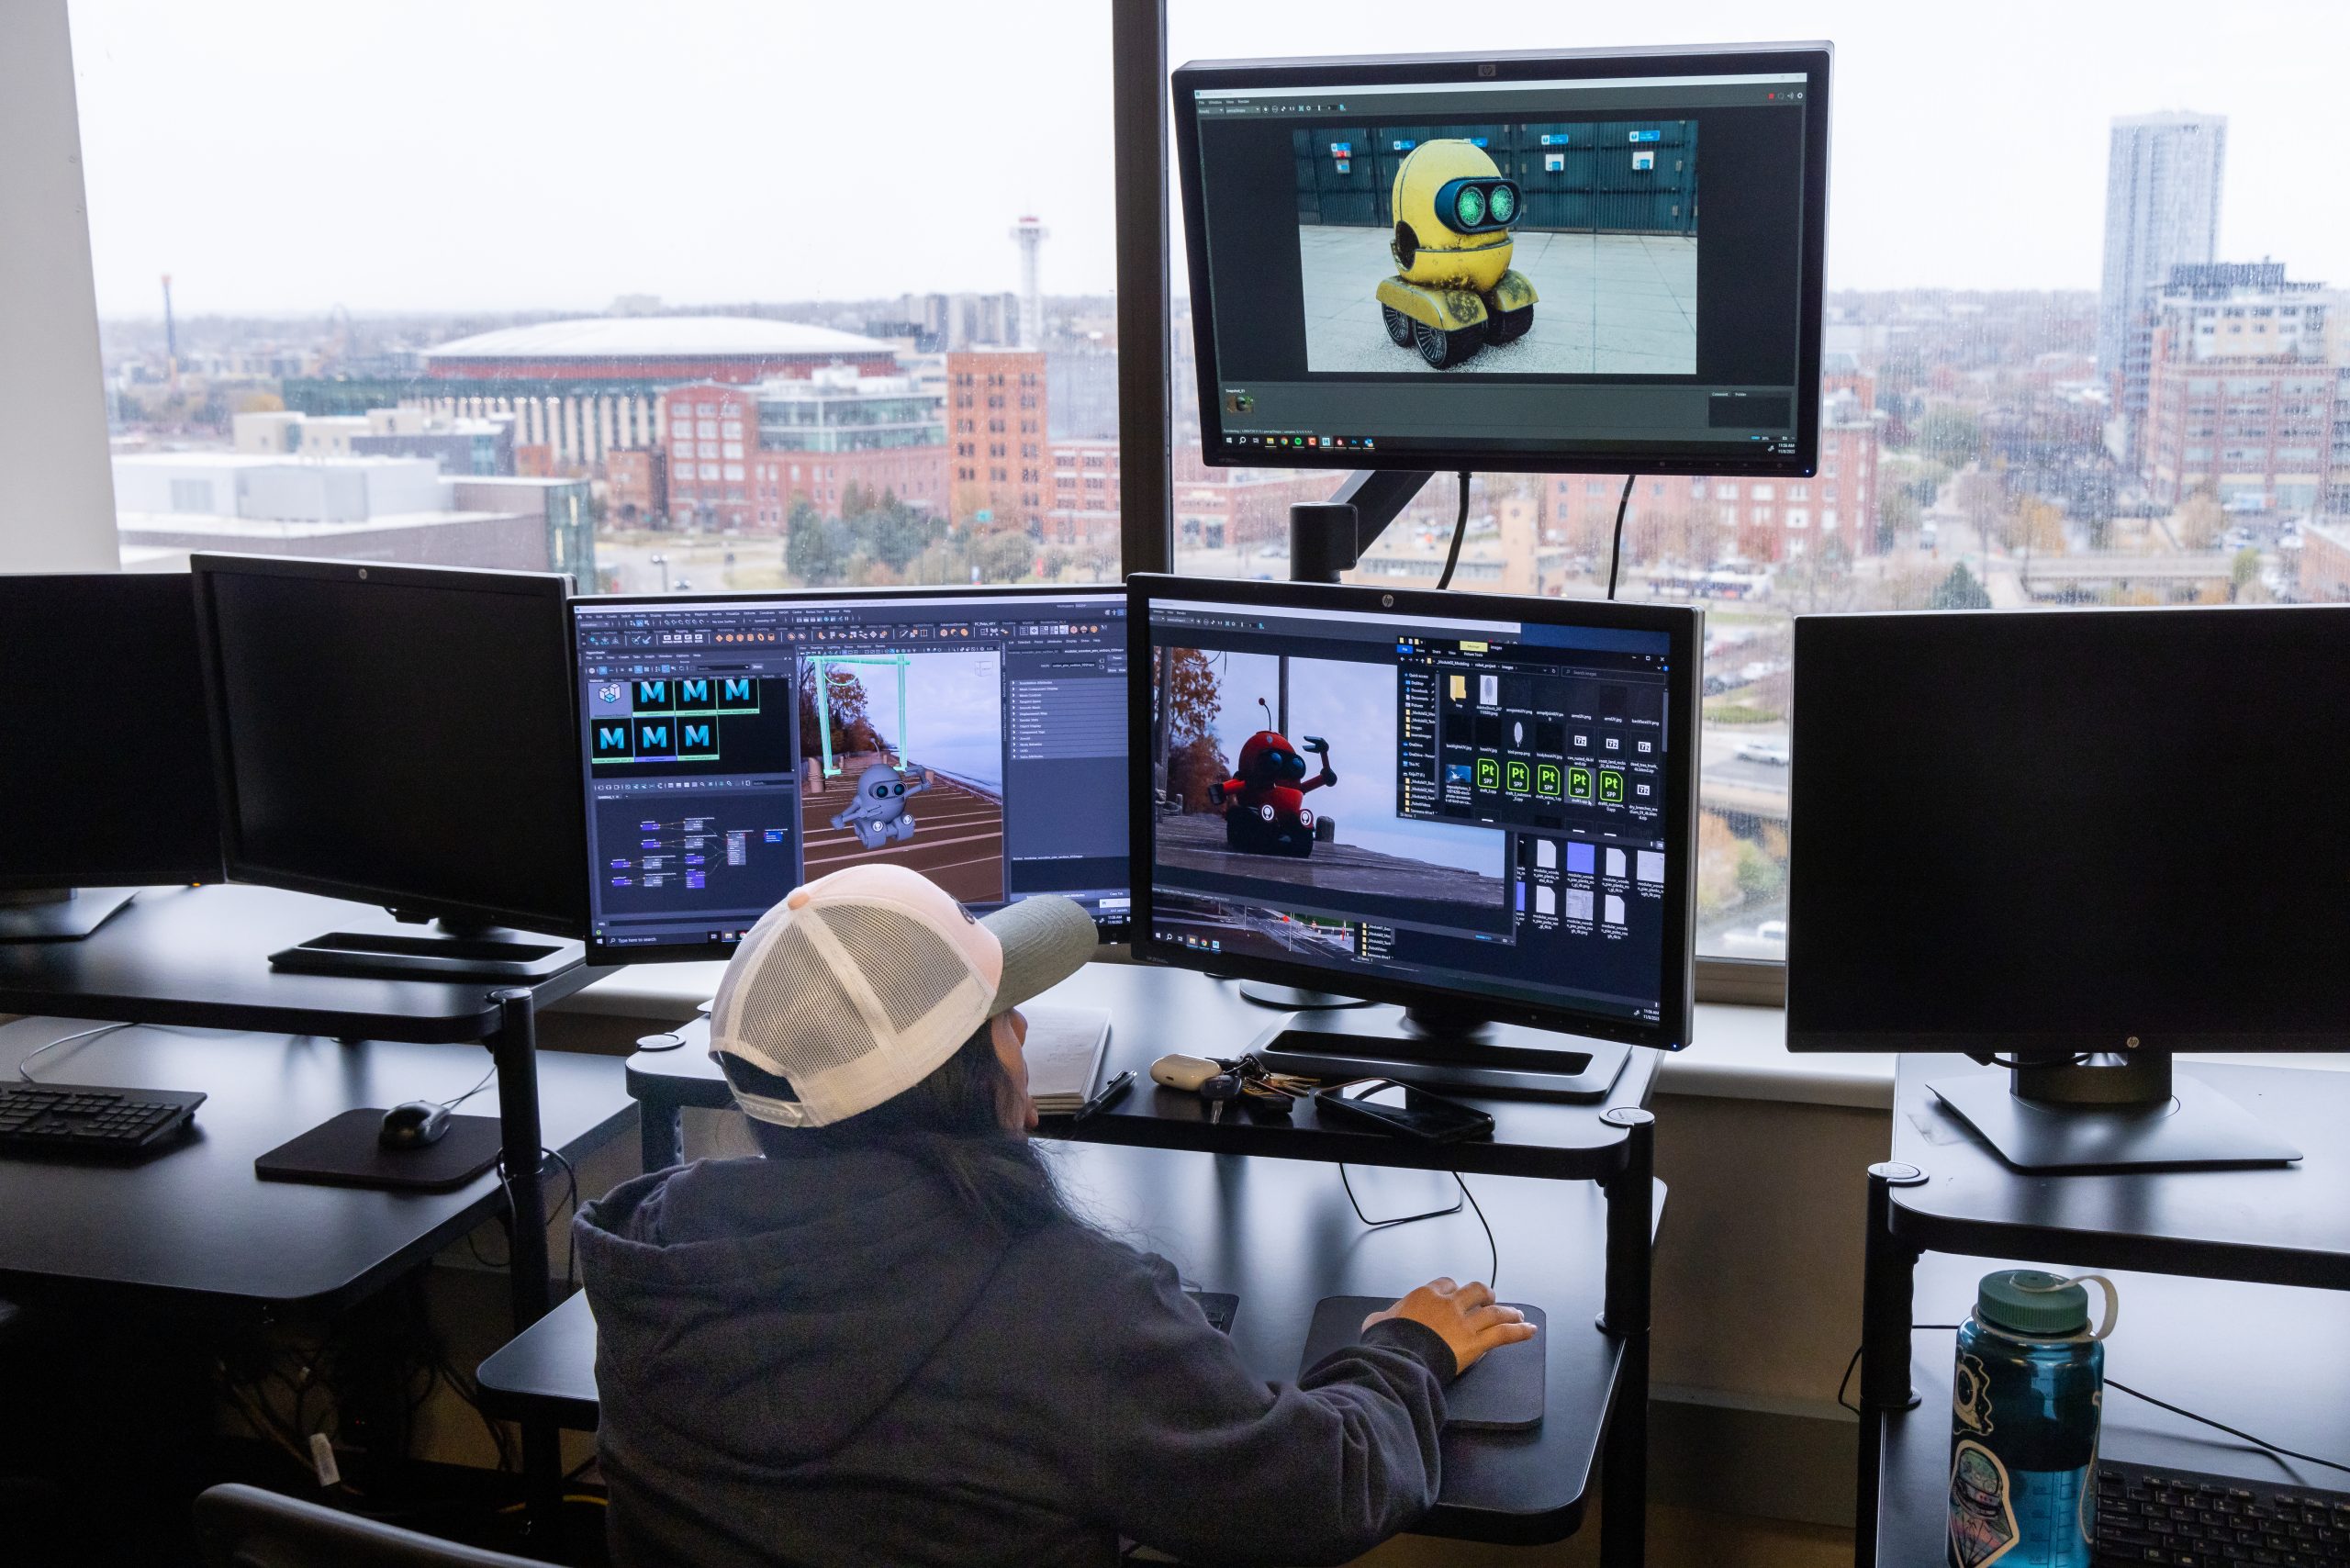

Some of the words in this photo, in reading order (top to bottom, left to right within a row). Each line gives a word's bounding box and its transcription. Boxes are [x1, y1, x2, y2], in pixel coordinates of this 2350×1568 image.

[600, 728, 624, 749] M
[643, 727, 667, 748] M
[685, 725, 709, 747] M
[1482, 765, 1494, 775] Pt
[1512, 767, 1524, 779] Pt
[1542, 771, 1555, 782] Pt
[1573, 774, 1586, 786] Pt
[1605, 777, 1618, 789] Pt
